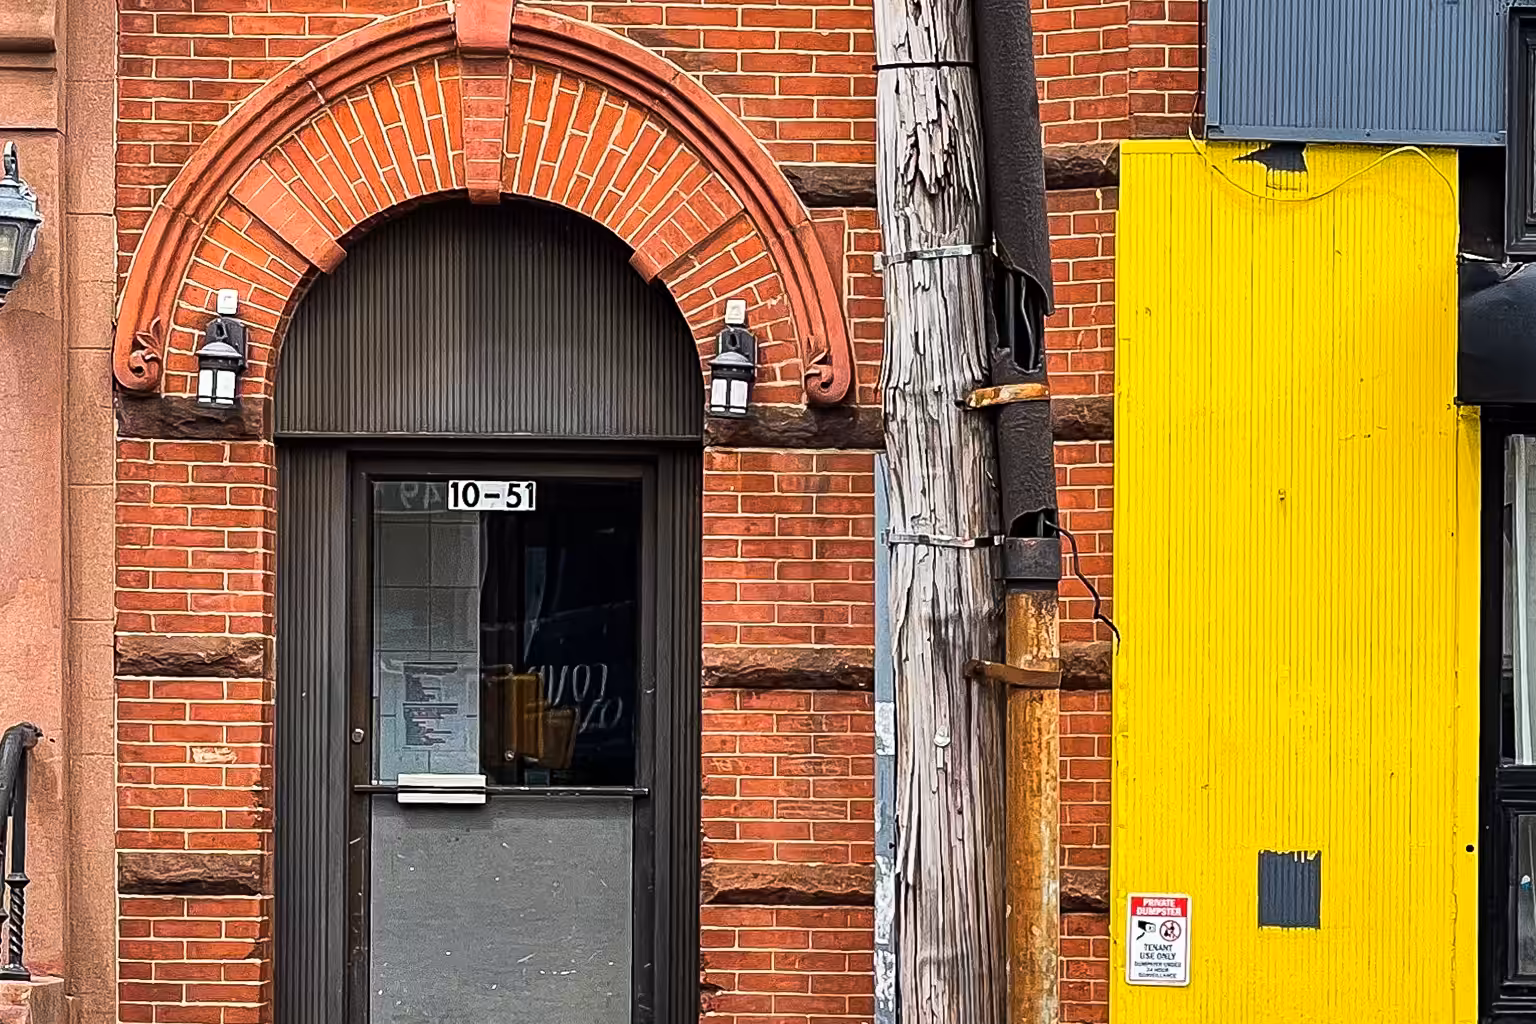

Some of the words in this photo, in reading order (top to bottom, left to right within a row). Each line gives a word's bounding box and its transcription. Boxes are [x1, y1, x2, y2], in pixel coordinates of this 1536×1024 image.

[450, 482, 534, 508] 10-51
[1143, 898, 1177, 908] PRIVATE
[1136, 906, 1183, 917] DUMPSTER
[1144, 943, 1173, 952] TENANT
[1139, 952, 1155, 960] USE
[1156, 952, 1176, 961] ONLY
